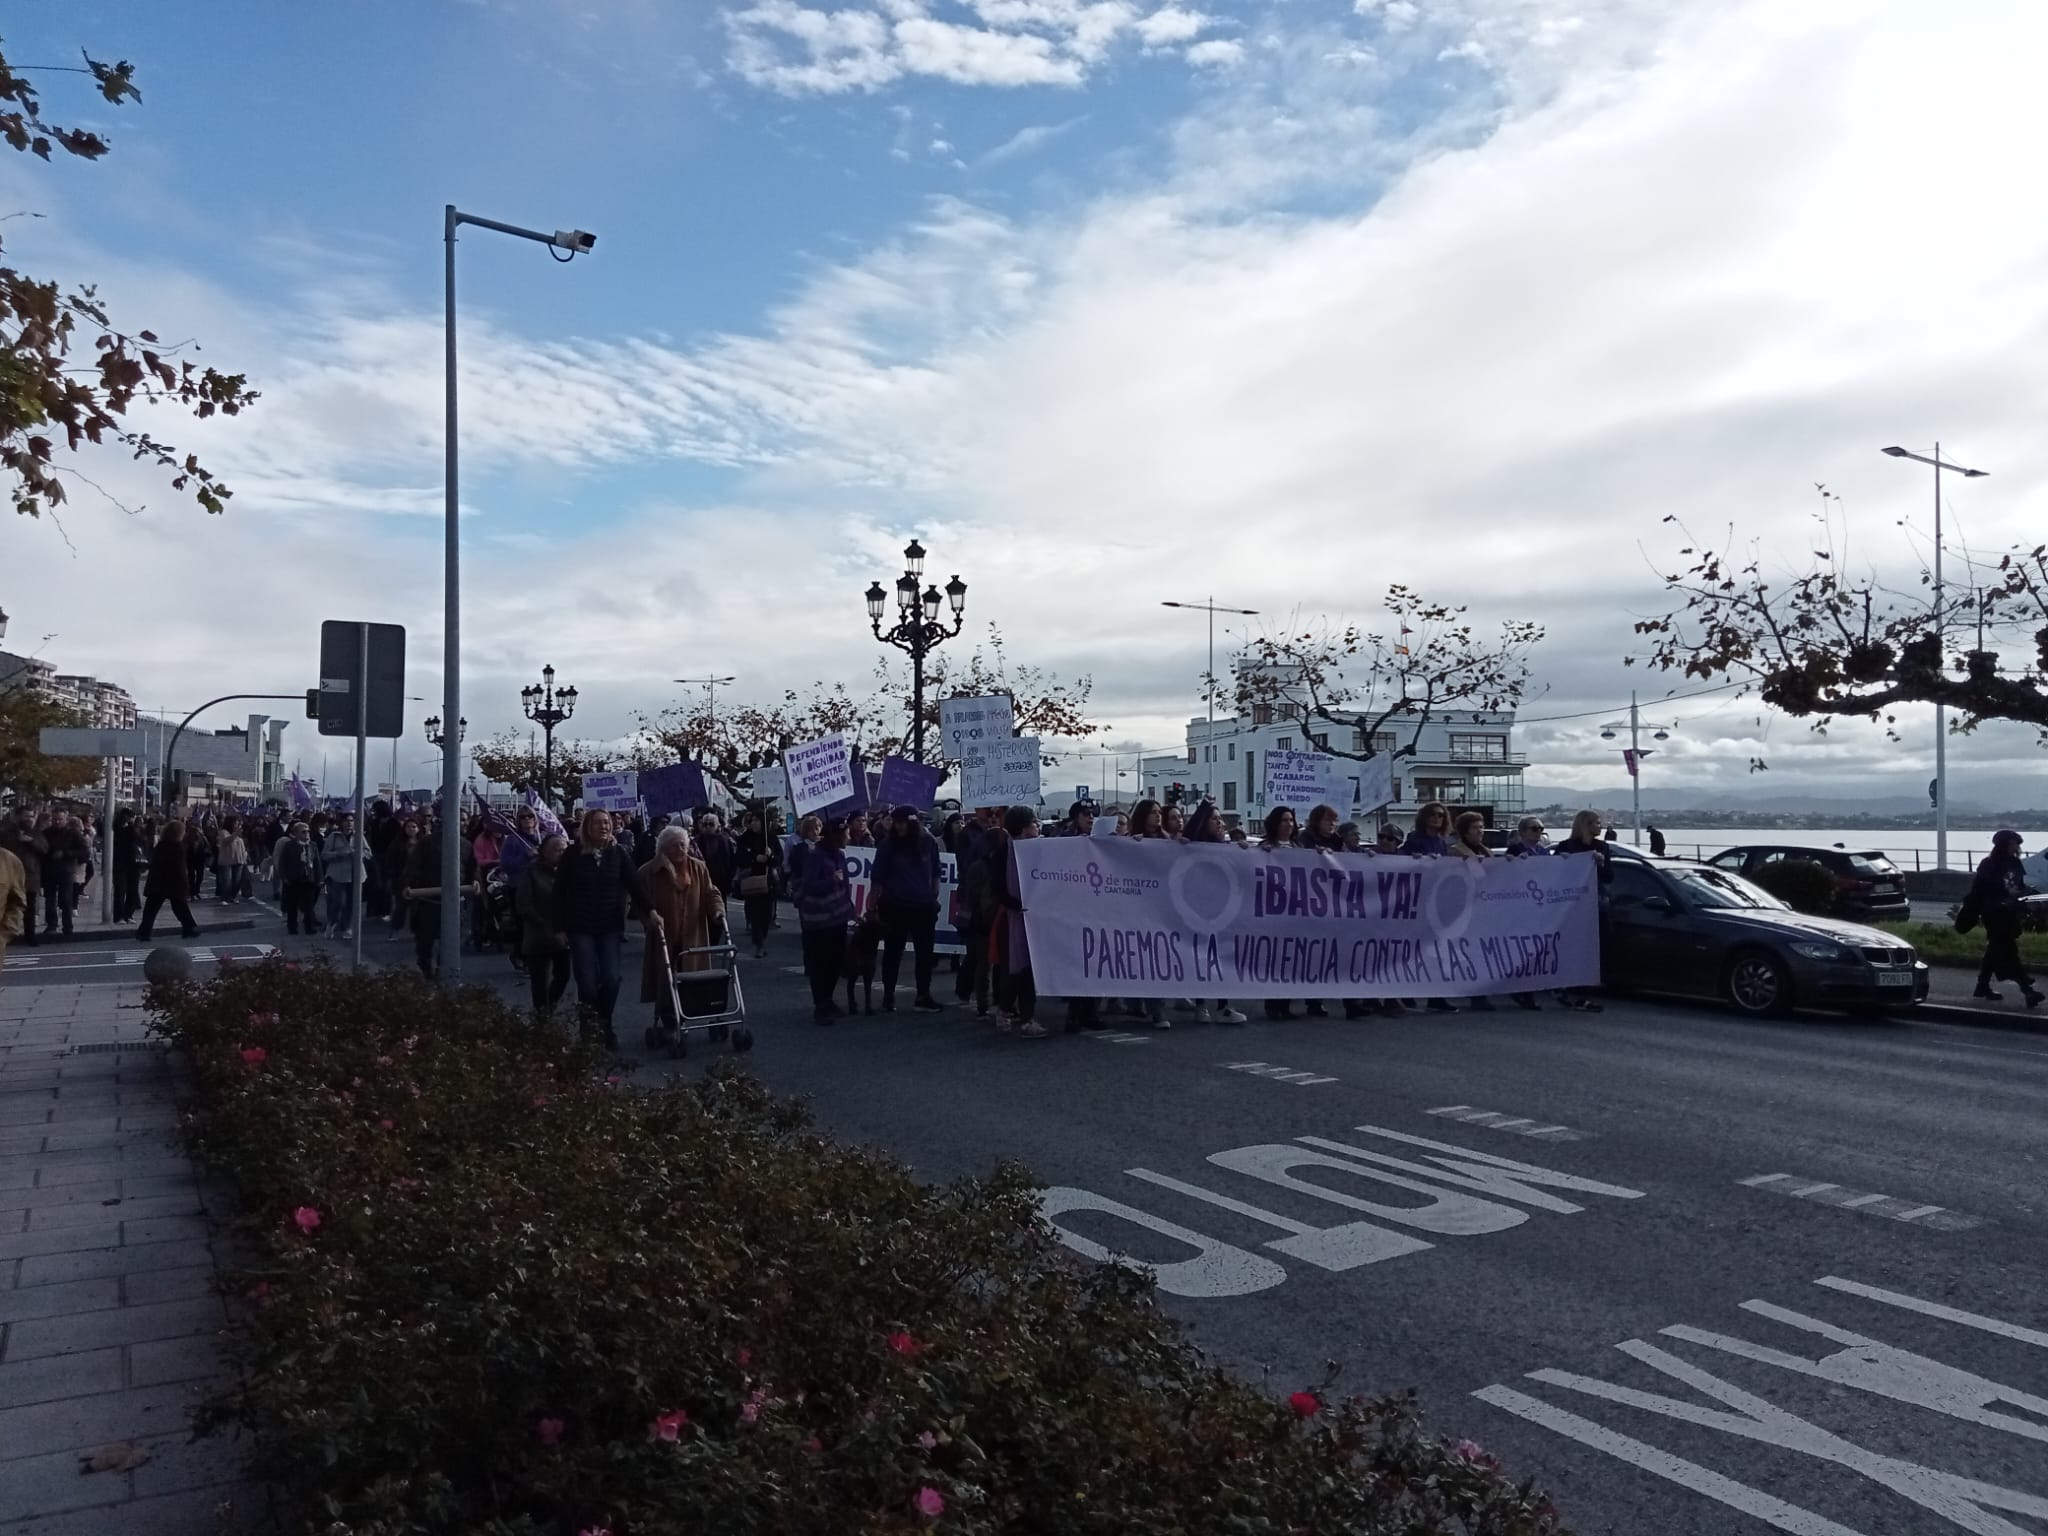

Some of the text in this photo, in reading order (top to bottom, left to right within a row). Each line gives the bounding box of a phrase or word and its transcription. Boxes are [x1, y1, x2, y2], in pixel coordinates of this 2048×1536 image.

[789, 739, 843, 763] DEFENDIENDO
[1267, 751, 1283, 759] NOS
[1267, 762, 1290, 770] TANTO
[1273, 772, 1315, 781] ACABARON
[1274, 794, 1285, 802] EL
[1105, 873, 1120, 886] de
[1122, 877, 1160, 889] marzo
[1254, 865, 1422, 920] ¡BASTA YA!
[1082, 927, 1561, 985] PAREMOS LA VIOLENCIA CONTRA LAS MUJERES
